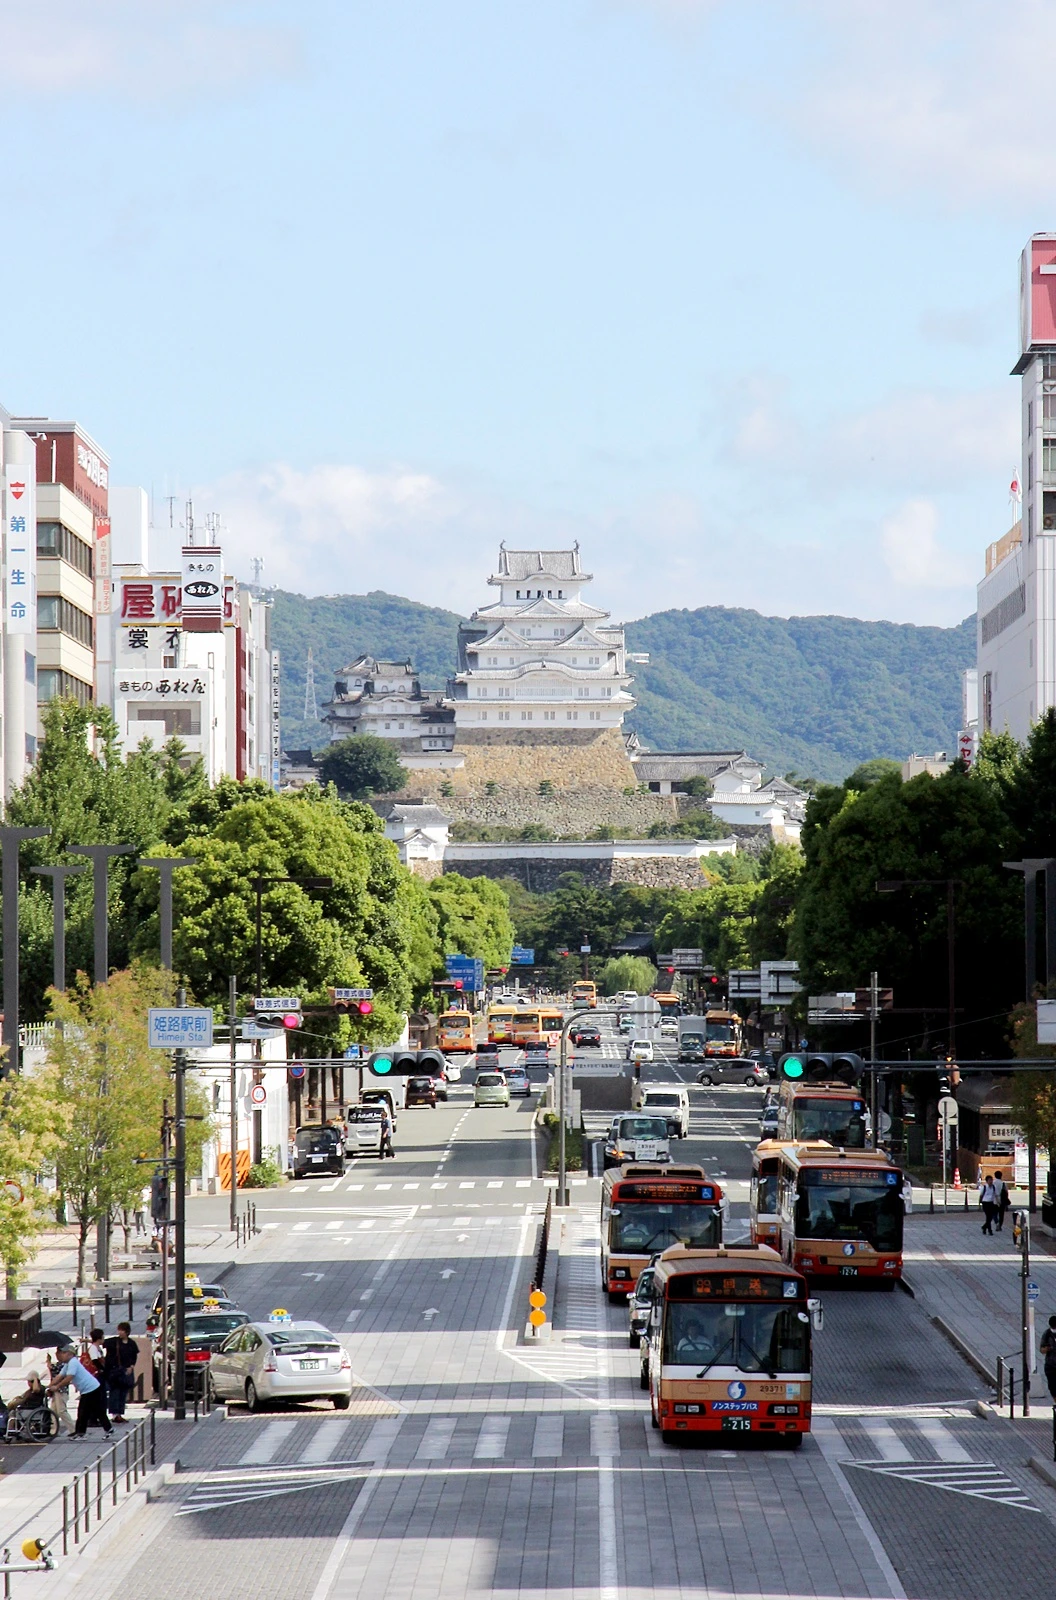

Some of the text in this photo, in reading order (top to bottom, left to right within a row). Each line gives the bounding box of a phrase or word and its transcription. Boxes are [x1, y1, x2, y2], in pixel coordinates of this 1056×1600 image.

[10, 515, 26, 619] 第一生命
[188, 563, 215, 572] きもの
[187, 585, 216, 594] 西松屋
[119, 678, 207, 695] きもの 西松屋
[336, 989, 372, 997] 時差式信号
[256, 998, 298, 1008] 時差式信号
[154, 1016, 207, 1032] 姫路駅前
[157, 1033, 205, 1042] Himeji Sta.
[723, 1278, 761, 1289] 回送
[713, 1402, 758, 1411] ノンステップバス
